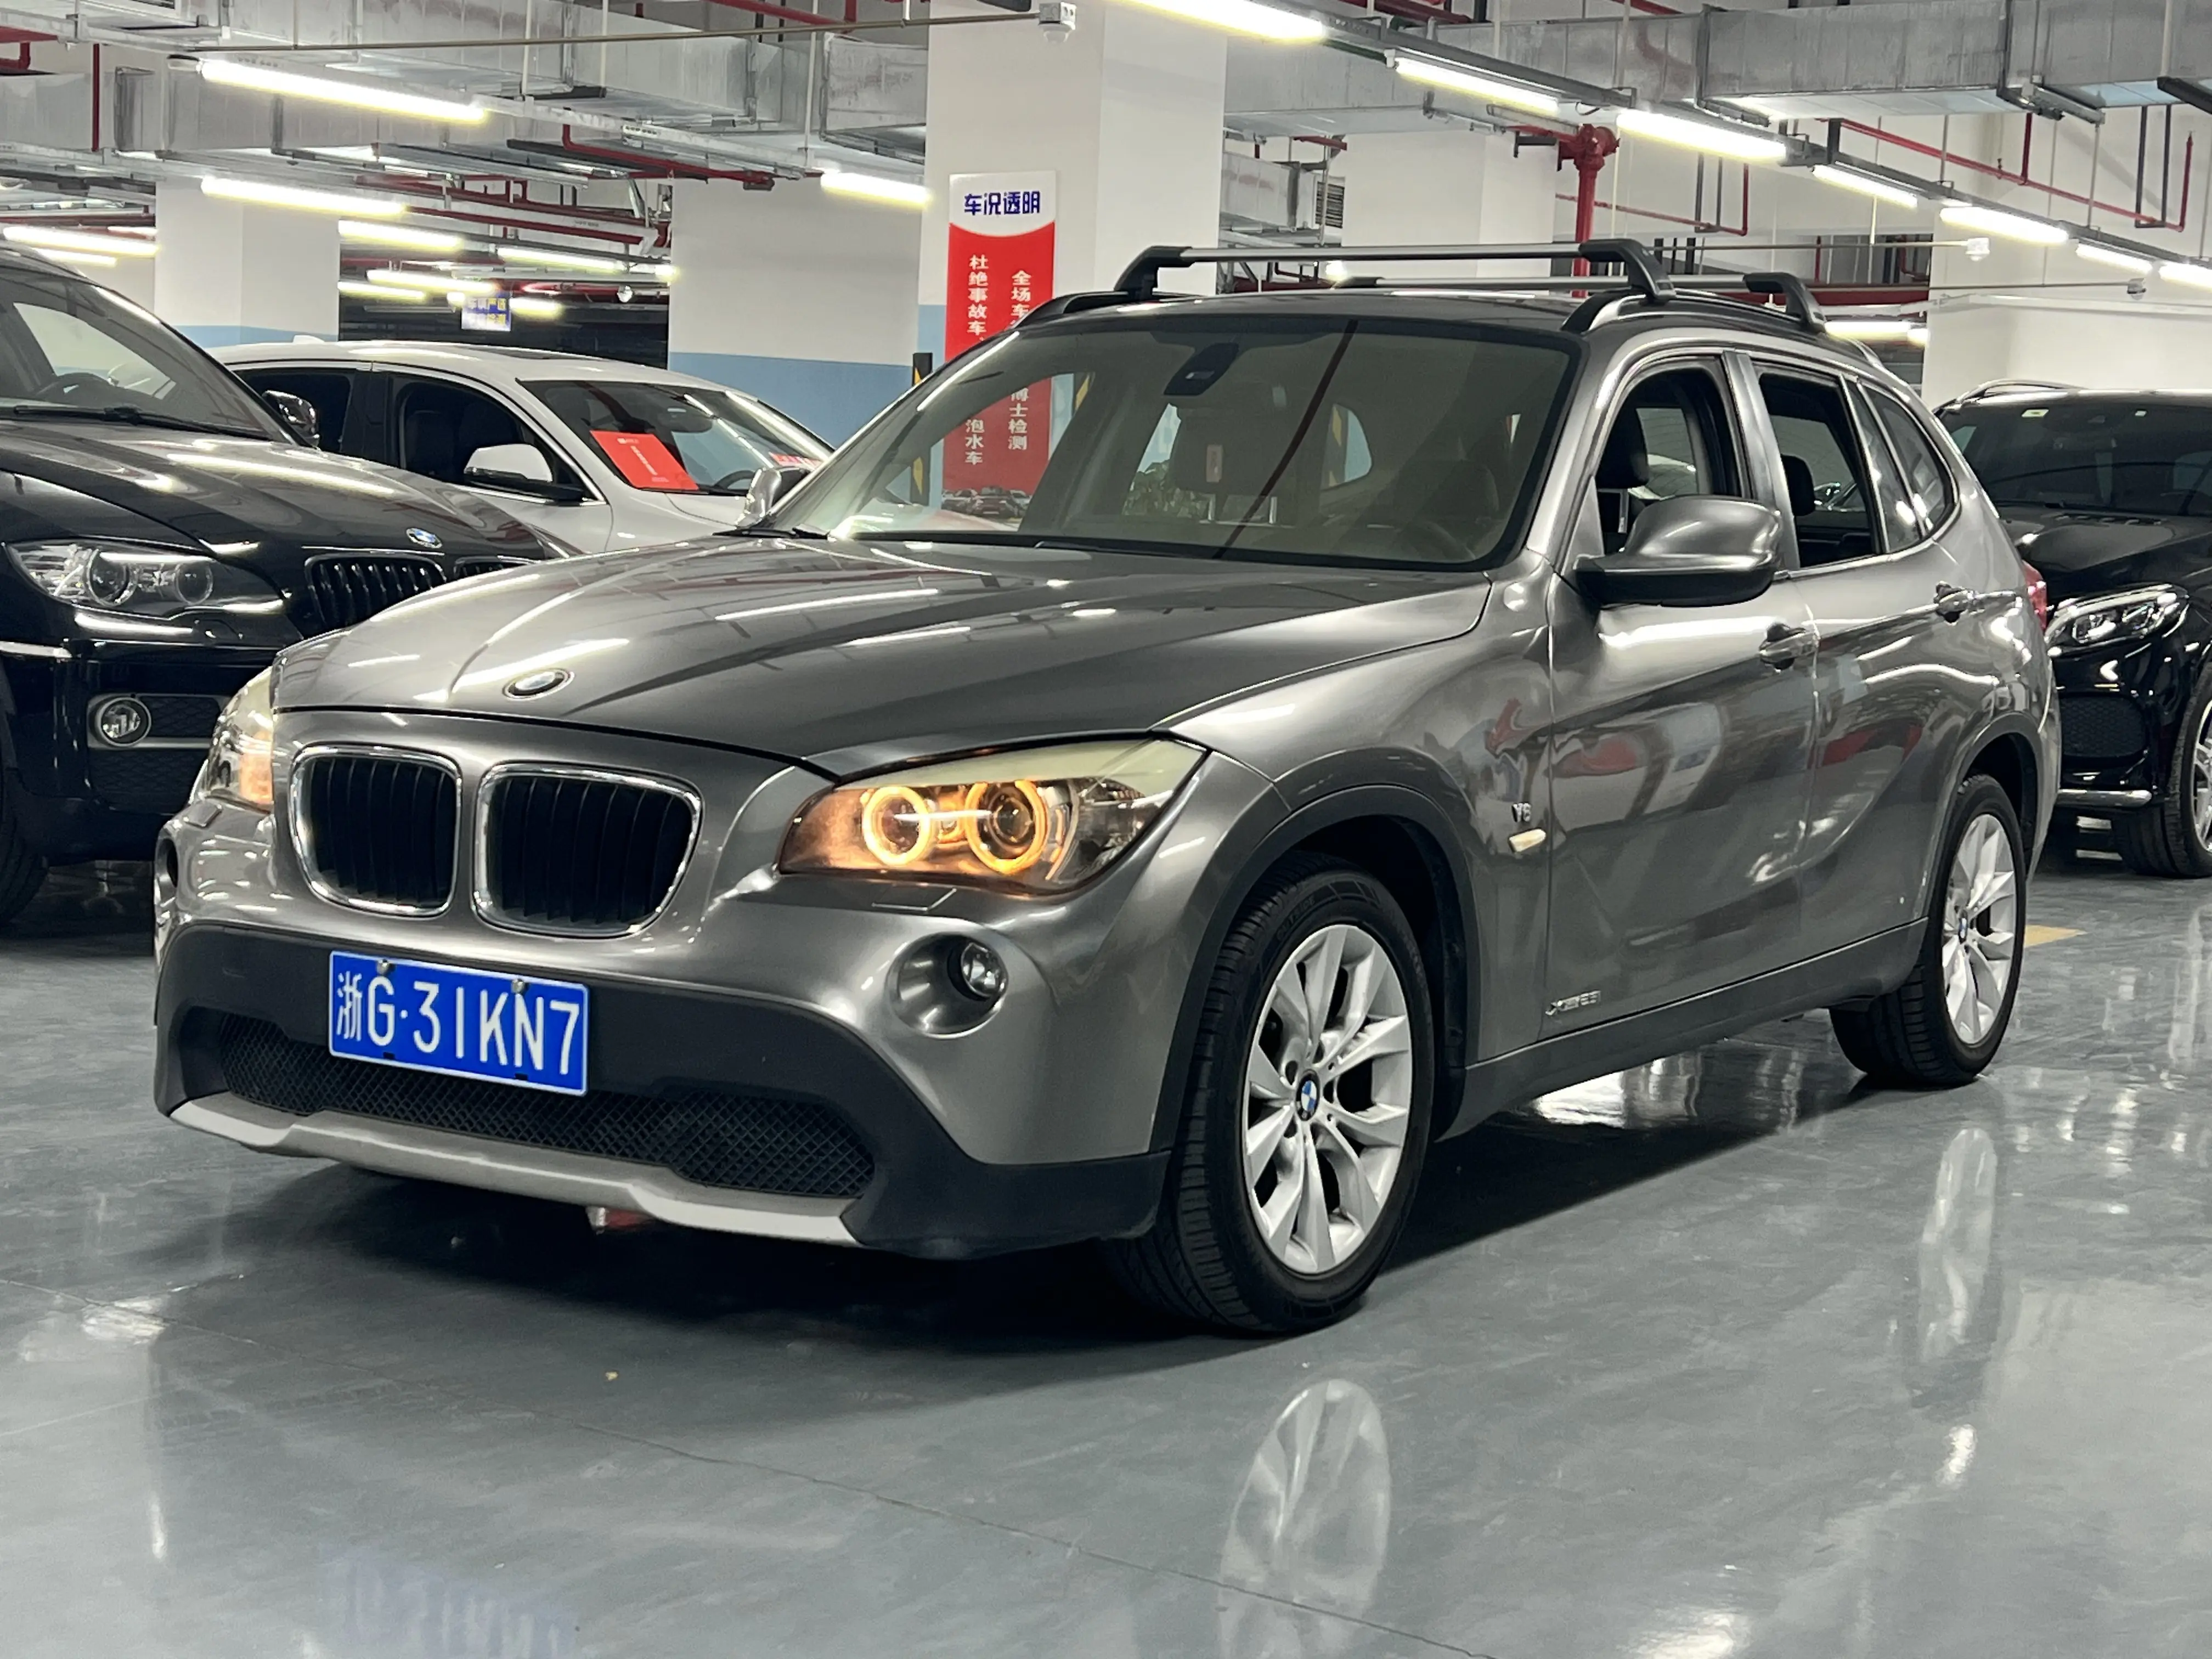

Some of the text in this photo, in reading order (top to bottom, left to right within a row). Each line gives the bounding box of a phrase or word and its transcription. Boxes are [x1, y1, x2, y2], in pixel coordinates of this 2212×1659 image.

[963, 190, 1041, 216] 车况透明
[964, 419, 985, 465] 泡水车
